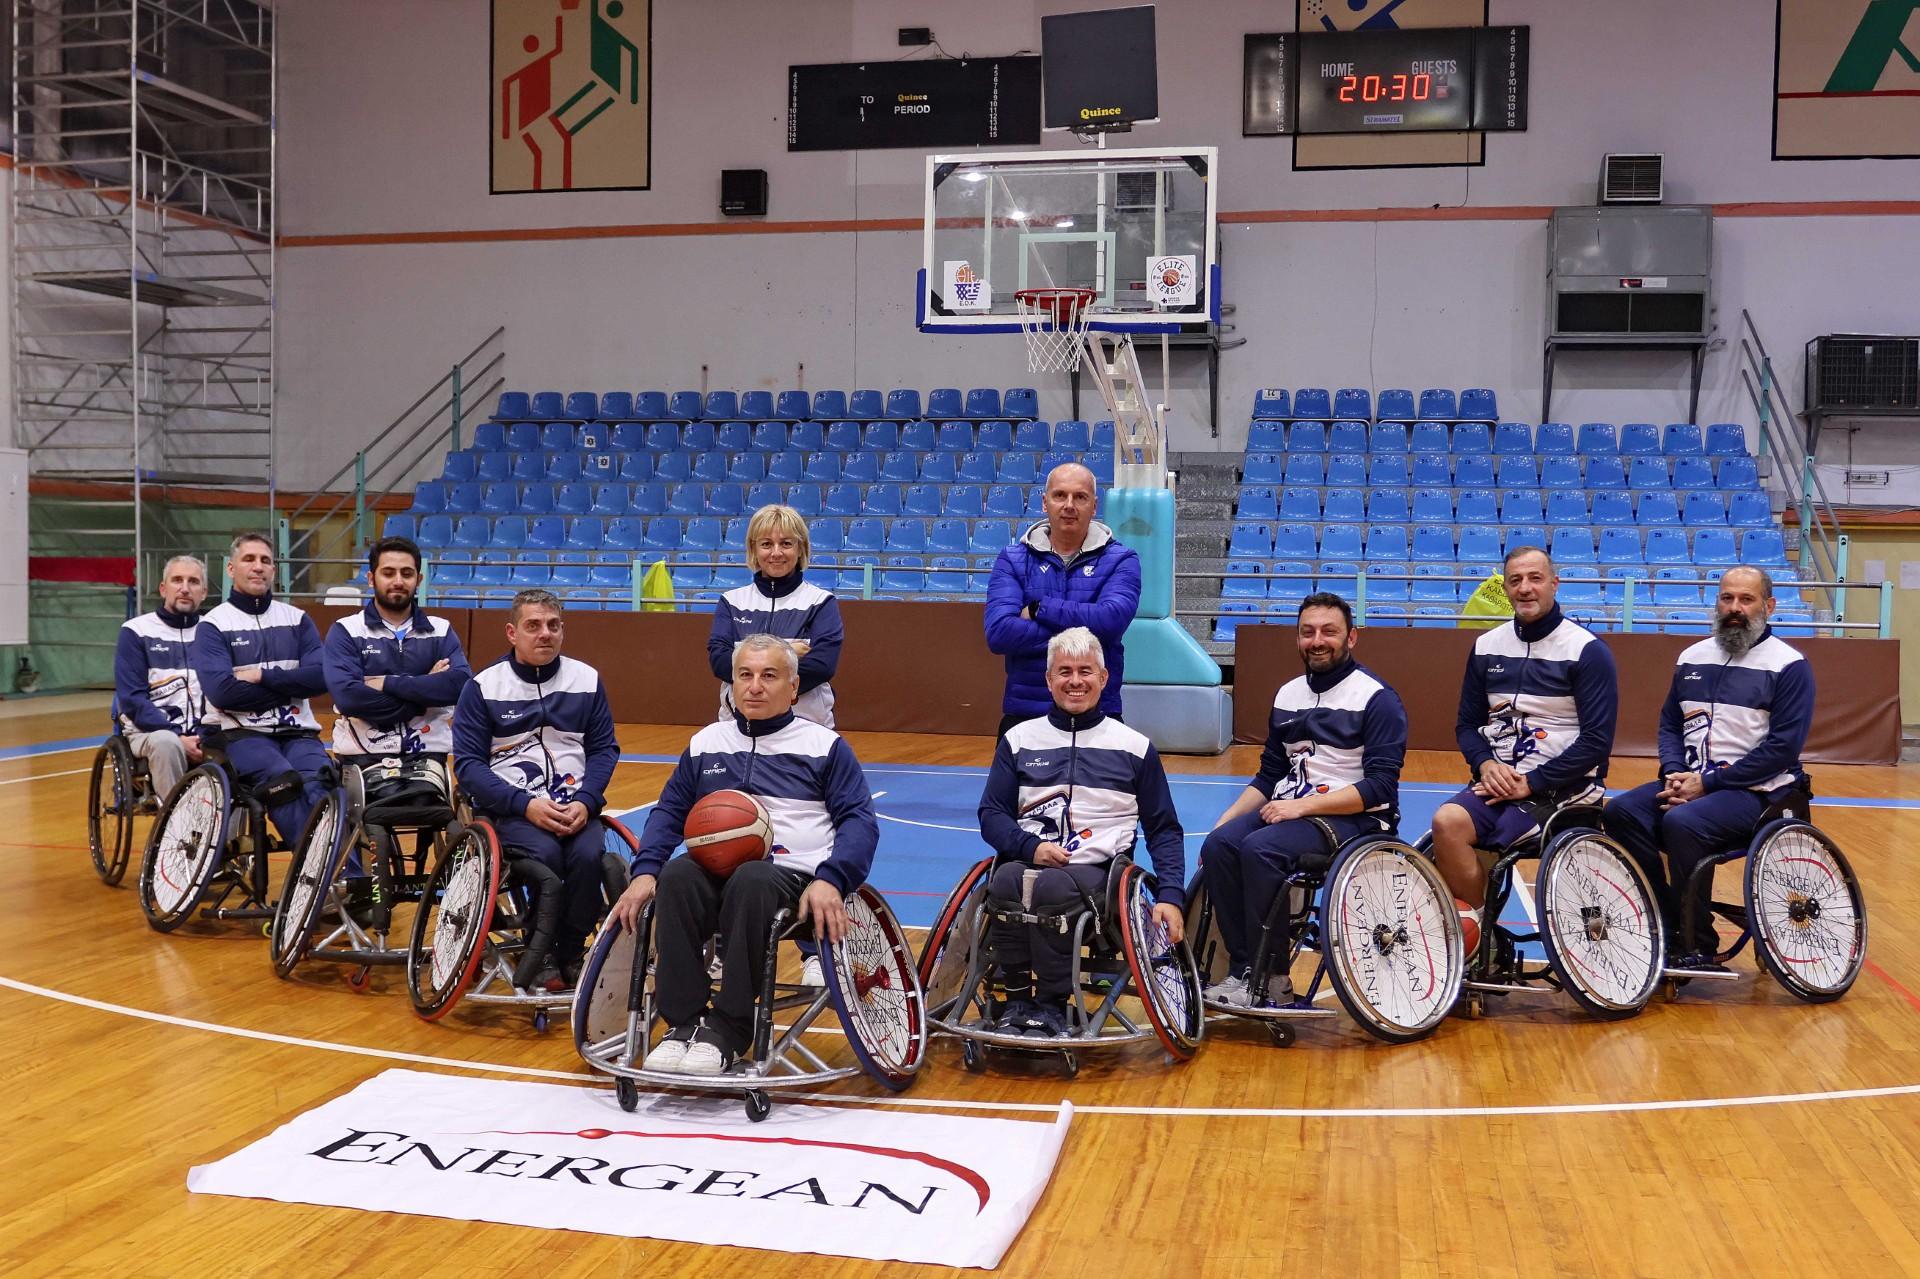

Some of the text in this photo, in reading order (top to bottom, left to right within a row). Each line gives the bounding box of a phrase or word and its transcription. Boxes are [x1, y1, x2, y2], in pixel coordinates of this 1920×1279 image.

[1321, 62, 1355, 78] HOME
[1411, 60, 1457, 75] GUESTS
[1340, 74, 1430, 102] 20:30
[861, 96, 874, 104] TO
[898, 94, 928, 102] Quince
[894, 105, 930, 114] PERIOD
[1080, 107, 1121, 119] Quince
[1157, 261, 1184, 272] ELITE
[1157, 281, 1186, 294] LEAGUE
[1762, 864, 1831, 896] ENERGEAN
[1565, 856, 1634, 935] ENERGEAN
[1352, 886, 1382, 1006] ENERGEAN
[306, 1128, 948, 1214] ENERGEAN
